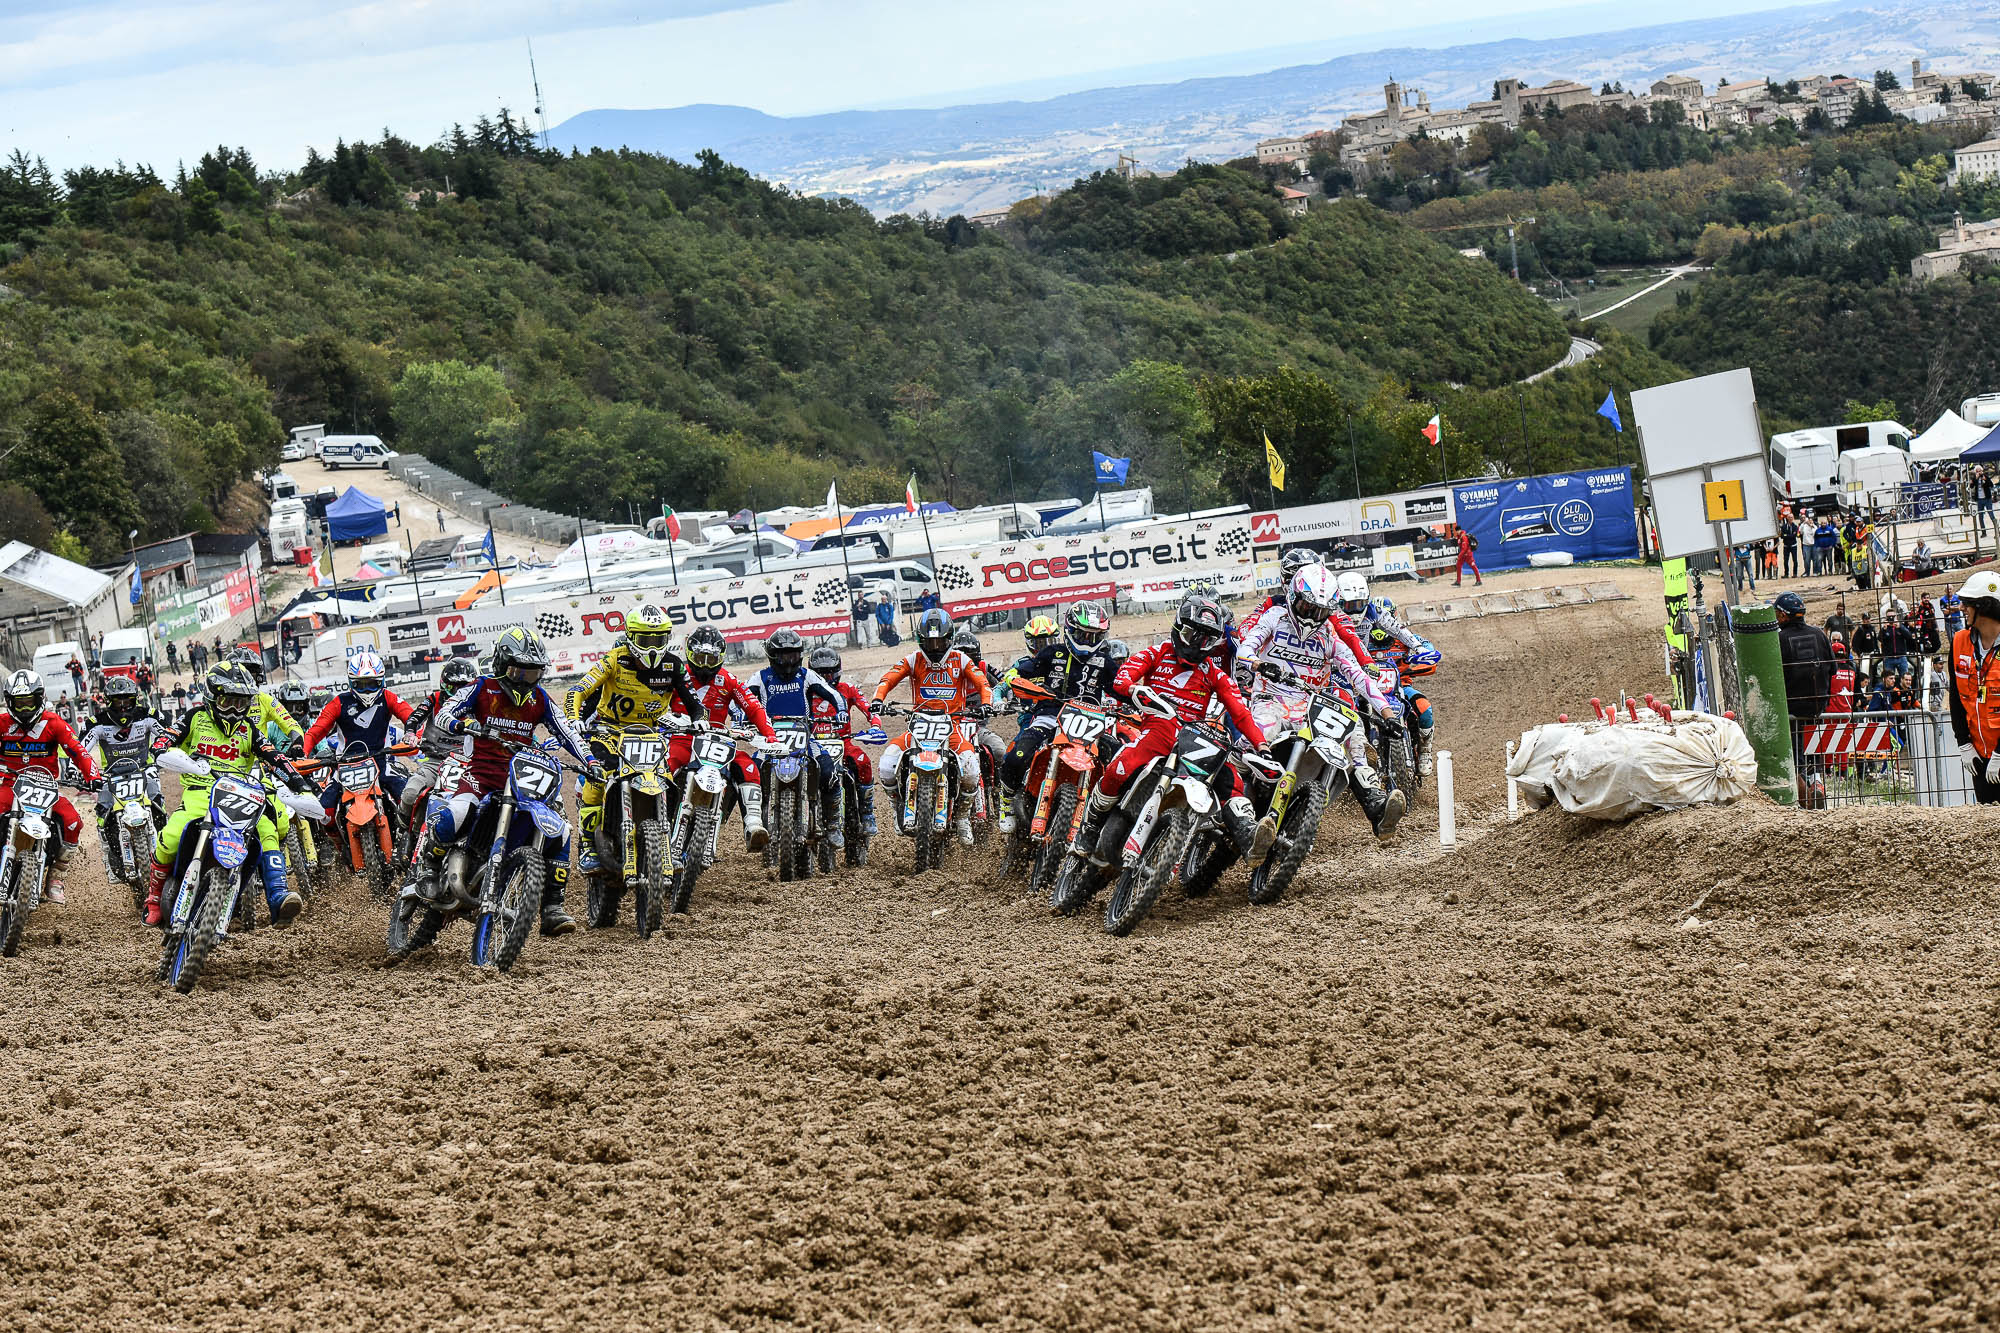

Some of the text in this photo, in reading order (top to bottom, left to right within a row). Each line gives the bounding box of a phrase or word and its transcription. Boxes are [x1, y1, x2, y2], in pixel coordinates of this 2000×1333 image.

[1595, 473, 1626, 485] YAMAHA
[1469, 488, 1499, 501] YAMAHA
[1718, 492, 1728, 511] 1
[880, 508, 940, 523] YAMAHA
[1413, 501, 1446, 514] Parker
[1563, 504, 1580, 516] bLU
[1360, 518, 1395, 531] D.R.A.
[1572, 512, 1590, 523] cRU
[1281, 520, 1340, 534] METALFUSIONI
[981, 533, 1207, 588] racestore.it
[1423, 546, 1459, 559] Parker
[1334, 557, 1373, 570] Parker
[1384, 561, 1413, 573] D.R.A.
[1416, 559, 1458, 570] DISTRIBUTO
[1256, 576, 1280, 588] D.R.A
[1037, 584, 1111, 601] GASGAS
[581, 583, 804, 636] rastore.it
[952, 596, 1027, 614] GASGAS
[396, 627, 429, 640] Parker
[392, 669, 430, 685] Parker
[775, 682, 801, 692] YAMAHA
[607, 692, 635, 721] K9
[486, 716, 533, 731] FIAMME ORO
[913, 722, 951, 740] 212
[1059, 712, 1105, 742] 102
[1314, 707, 1349, 740] 5
[4, 743, 47, 752] DR. JACK
[776, 730, 807, 749] 270
[623, 742, 662, 765] 146
[699, 740, 730, 763] 18
[1181, 736, 1221, 761] 7
[340, 766, 375, 787] 321
[518, 766, 555, 795] 21
[18, 785, 57, 807] 237
[115, 778, 144, 799] 511
[217, 793, 260, 816] 278
